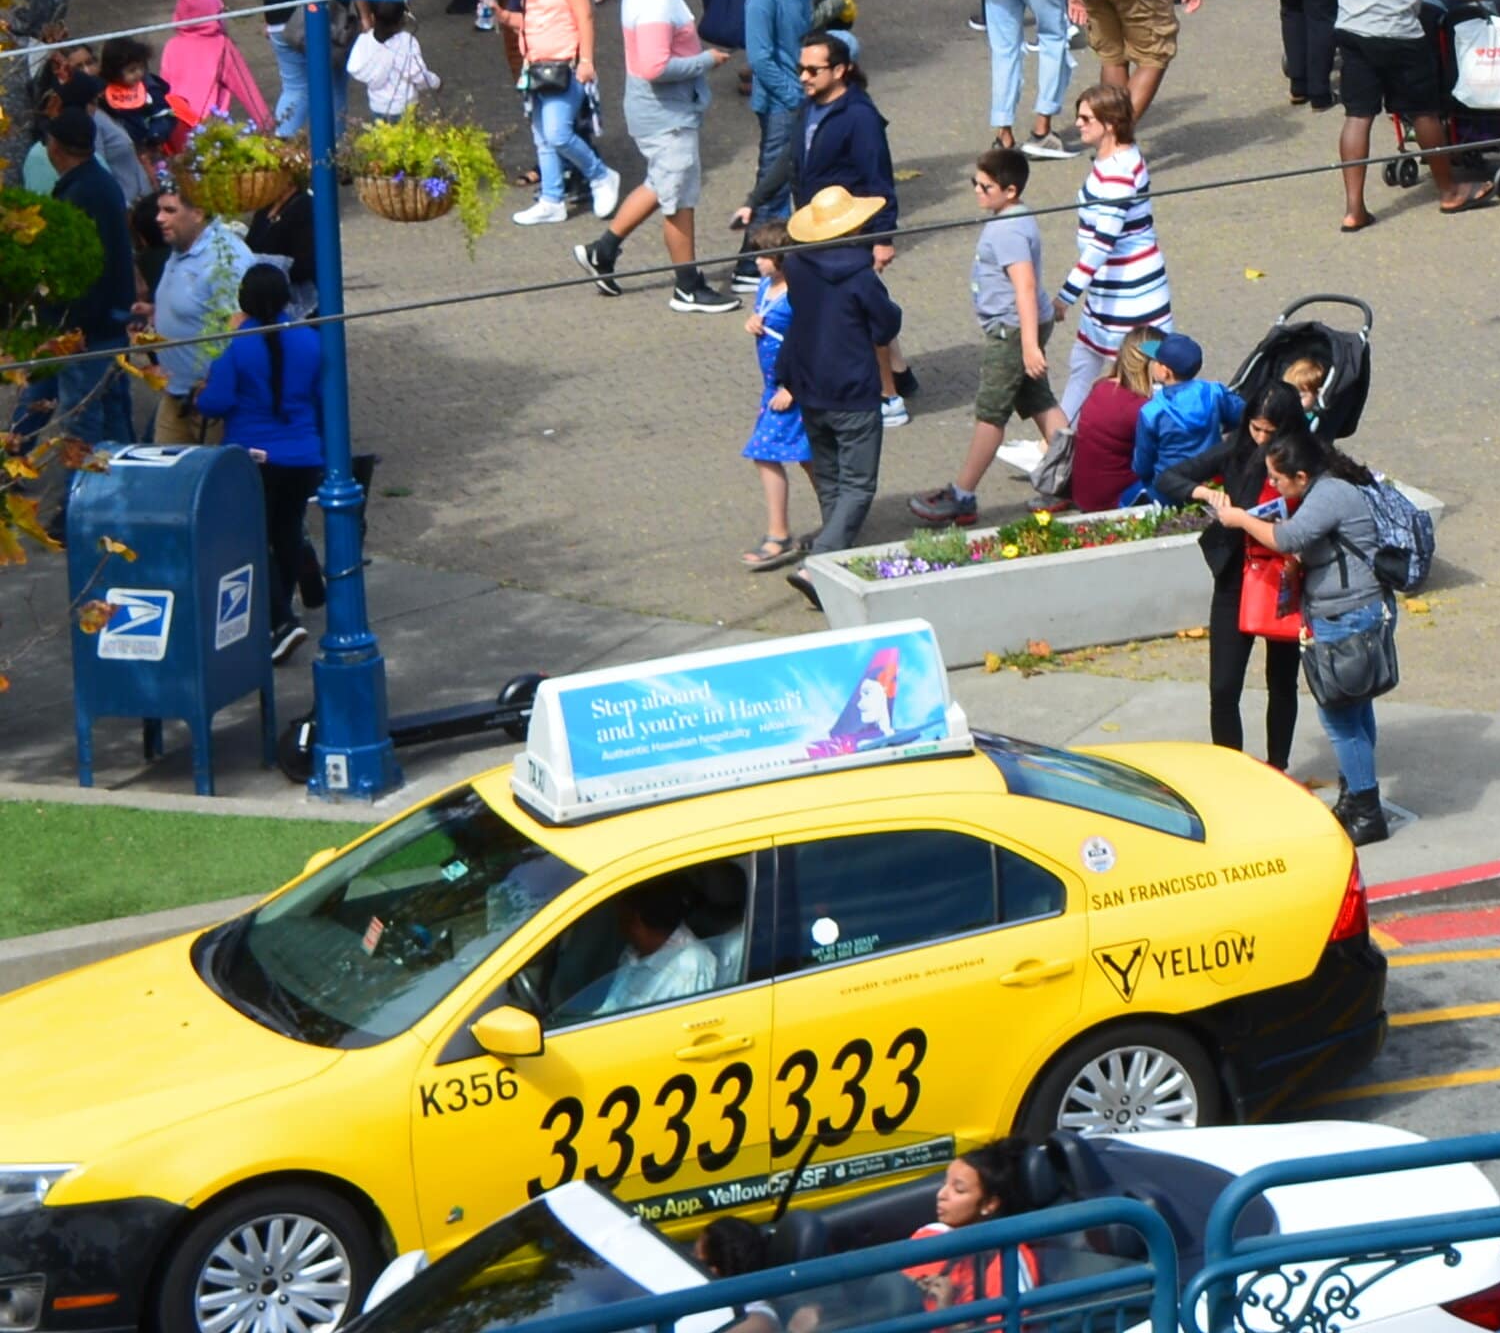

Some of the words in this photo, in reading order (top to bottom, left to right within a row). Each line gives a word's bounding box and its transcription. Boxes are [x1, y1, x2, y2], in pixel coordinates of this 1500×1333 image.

[590, 693, 638, 725] Step
[641, 680, 712, 710] aboard
[596, 718, 636, 743] and
[638, 707, 701, 741] you're
[704, 703, 727, 725] in
[601, 743, 649, 762] Authentic
[651, 735, 699, 754] Hawaiian
[699, 727, 751, 751] hospitality
[527, 757, 546, 793] TAXI
[1091, 889, 1126, 911] SAN
[1129, 872, 1218, 904] FRANCISCO
[1221, 858, 1288, 883] TAXICAB
[839, 979, 880, 996] credit
[882, 971, 921, 988] cards
[924, 956, 987, 980] accepted
[1152, 935, 1256, 980] YELLOW
[418, 1066, 519, 1118] K356
[664, 1196, 704, 1220] App.
